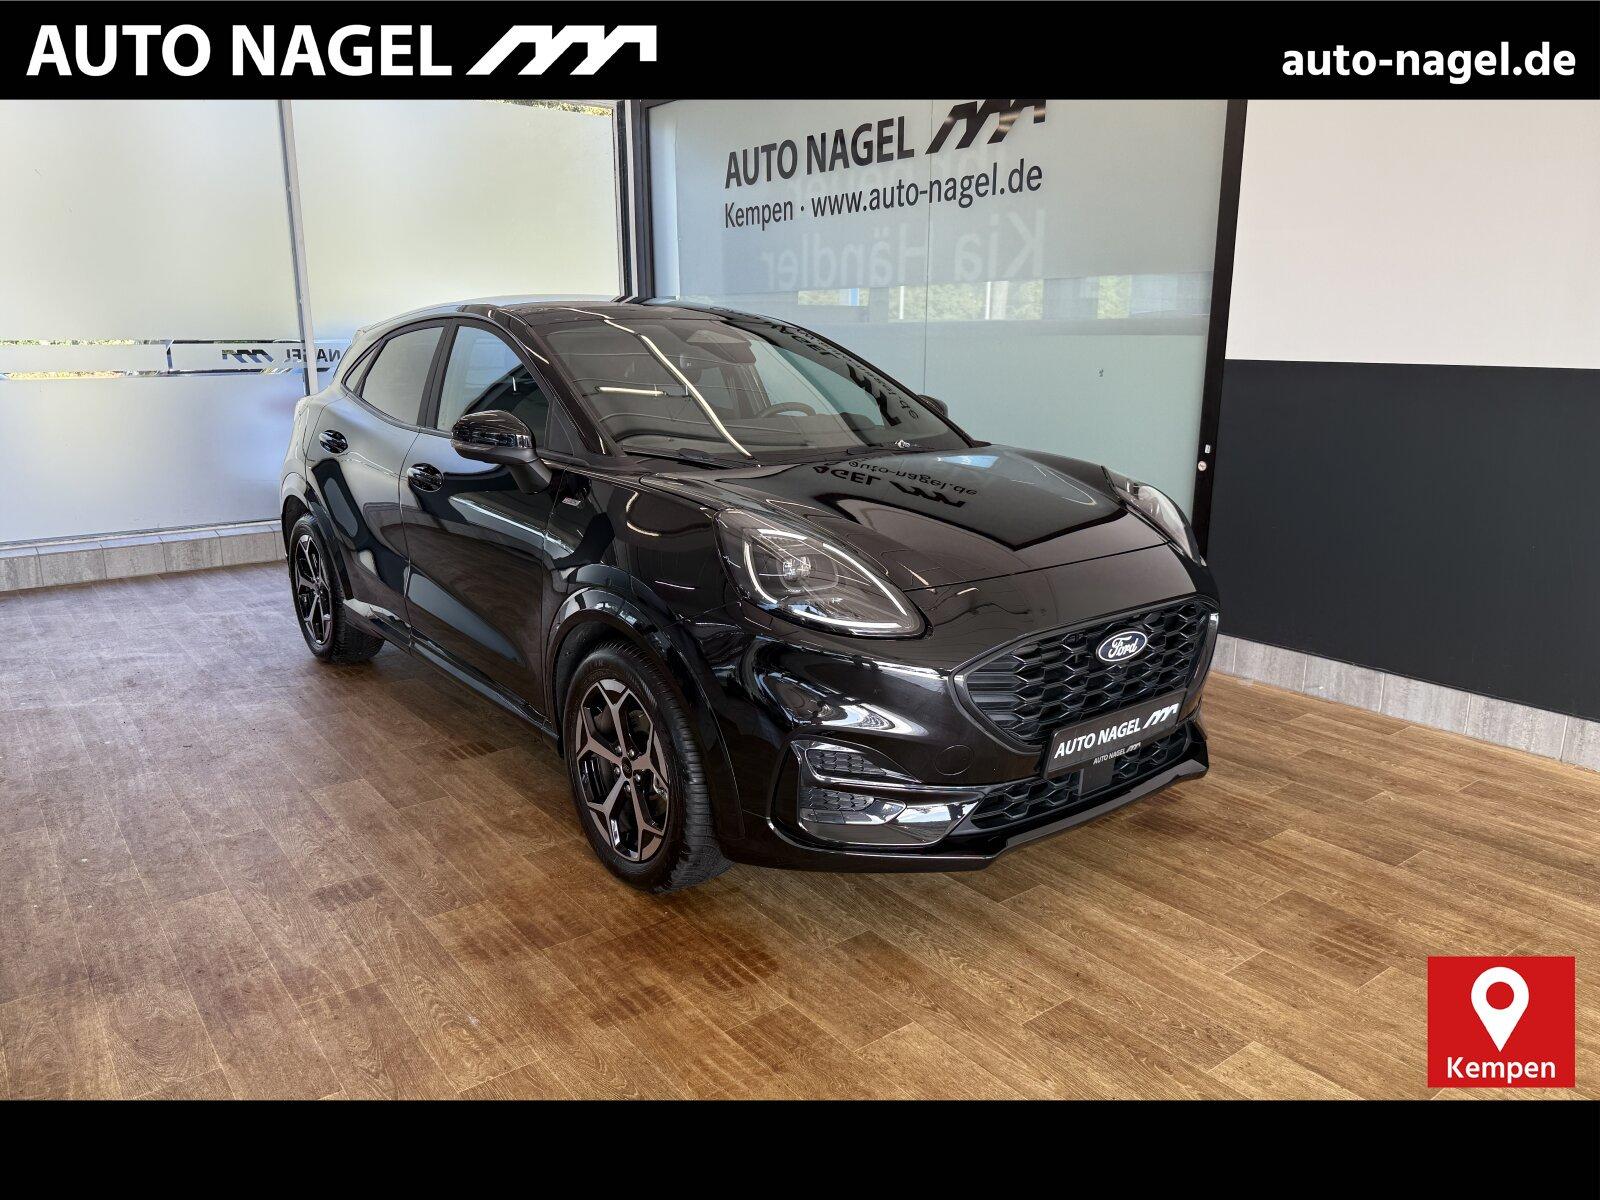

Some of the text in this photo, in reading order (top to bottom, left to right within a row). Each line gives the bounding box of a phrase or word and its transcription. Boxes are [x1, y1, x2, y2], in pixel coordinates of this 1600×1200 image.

[724, 115, 915, 189] AUTO NAGEL
[724, 158, 1043, 231] Kempen www.auto-nagel.de
[1108, 635, 1139, 659] Ford
[1054, 718, 1141, 759] AUTO NAGEL
[1093, 748, 1126, 765] AUTO NAGEL
